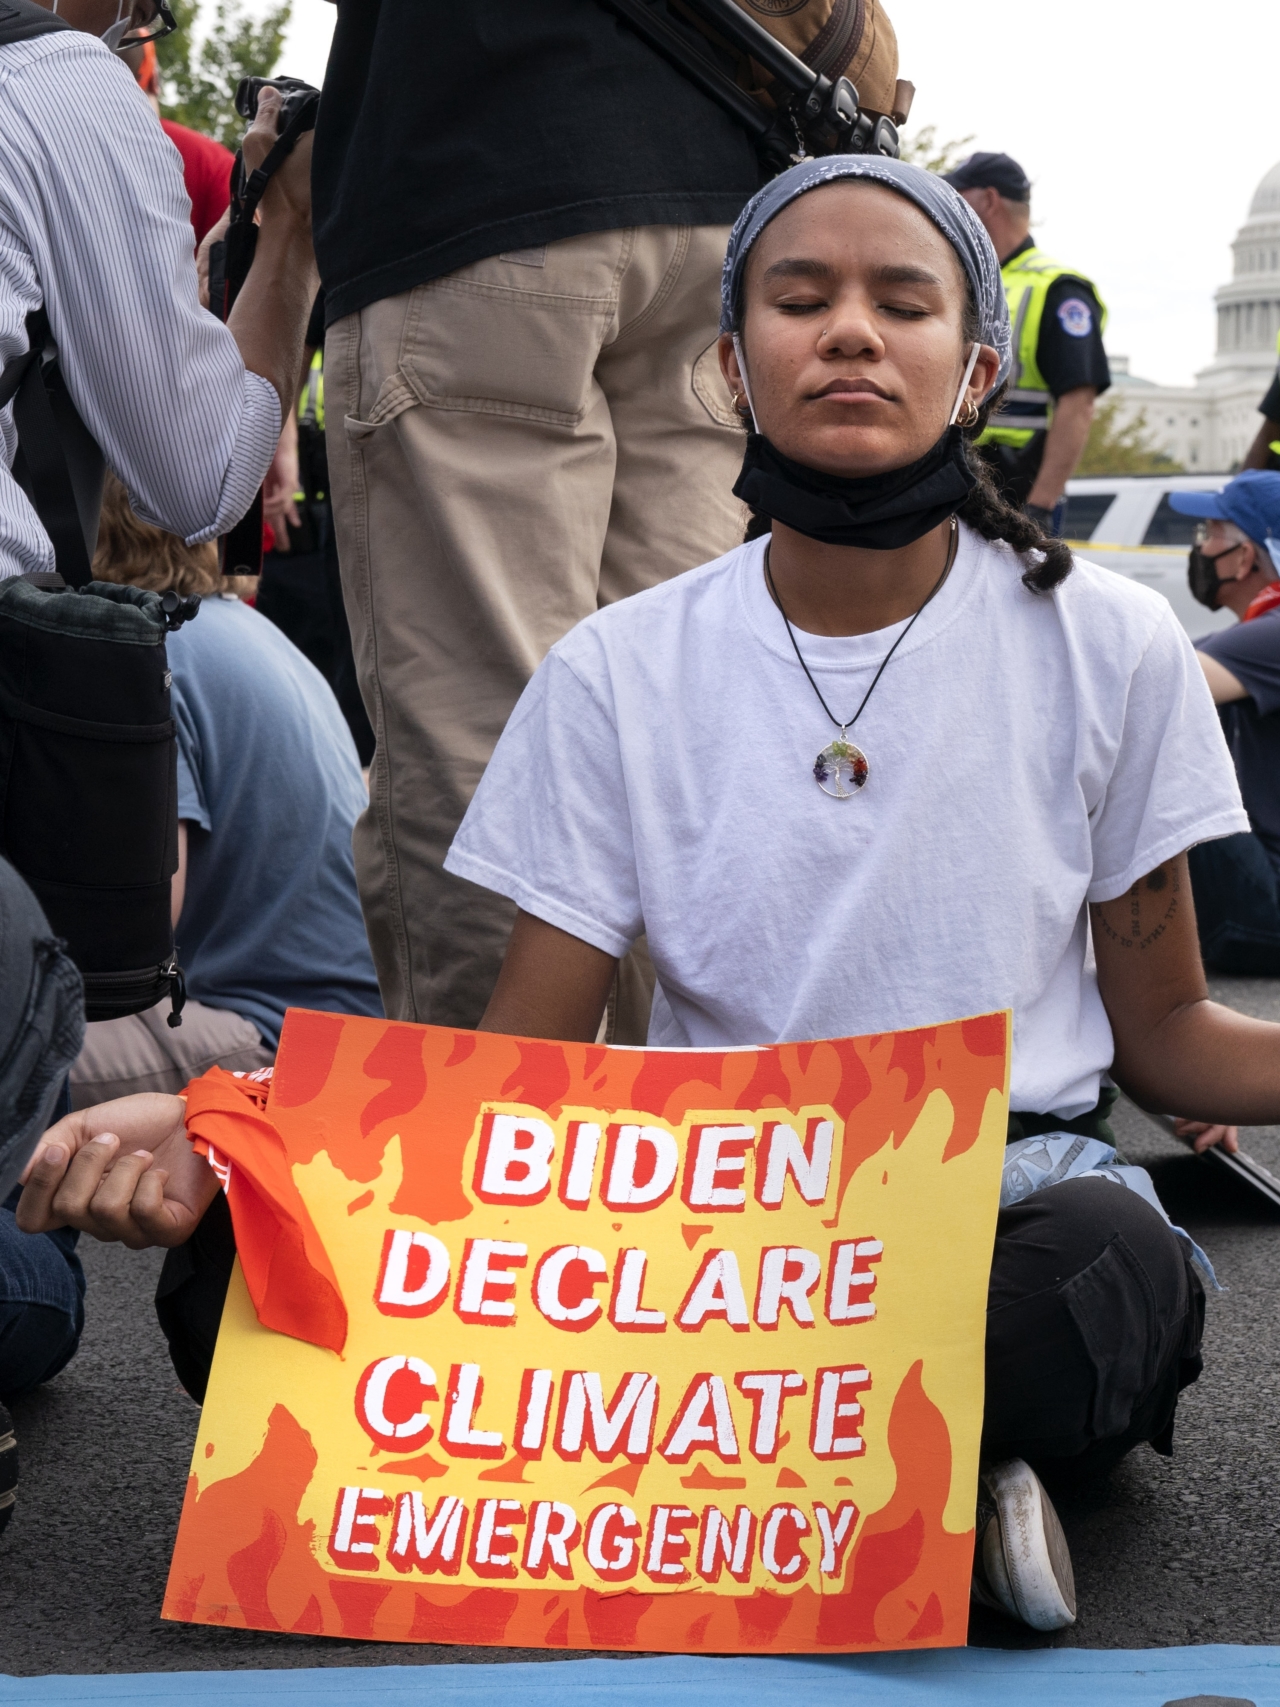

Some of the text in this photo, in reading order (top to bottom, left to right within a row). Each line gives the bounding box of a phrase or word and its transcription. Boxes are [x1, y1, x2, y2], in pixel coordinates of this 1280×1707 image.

[479, 1114, 834, 1212] BIDEN
[376, 1229, 884, 1333] DECLARE
[355, 1354, 872, 1464] CLIMATE
[327, 1485, 857, 1585] EMERGENCY
